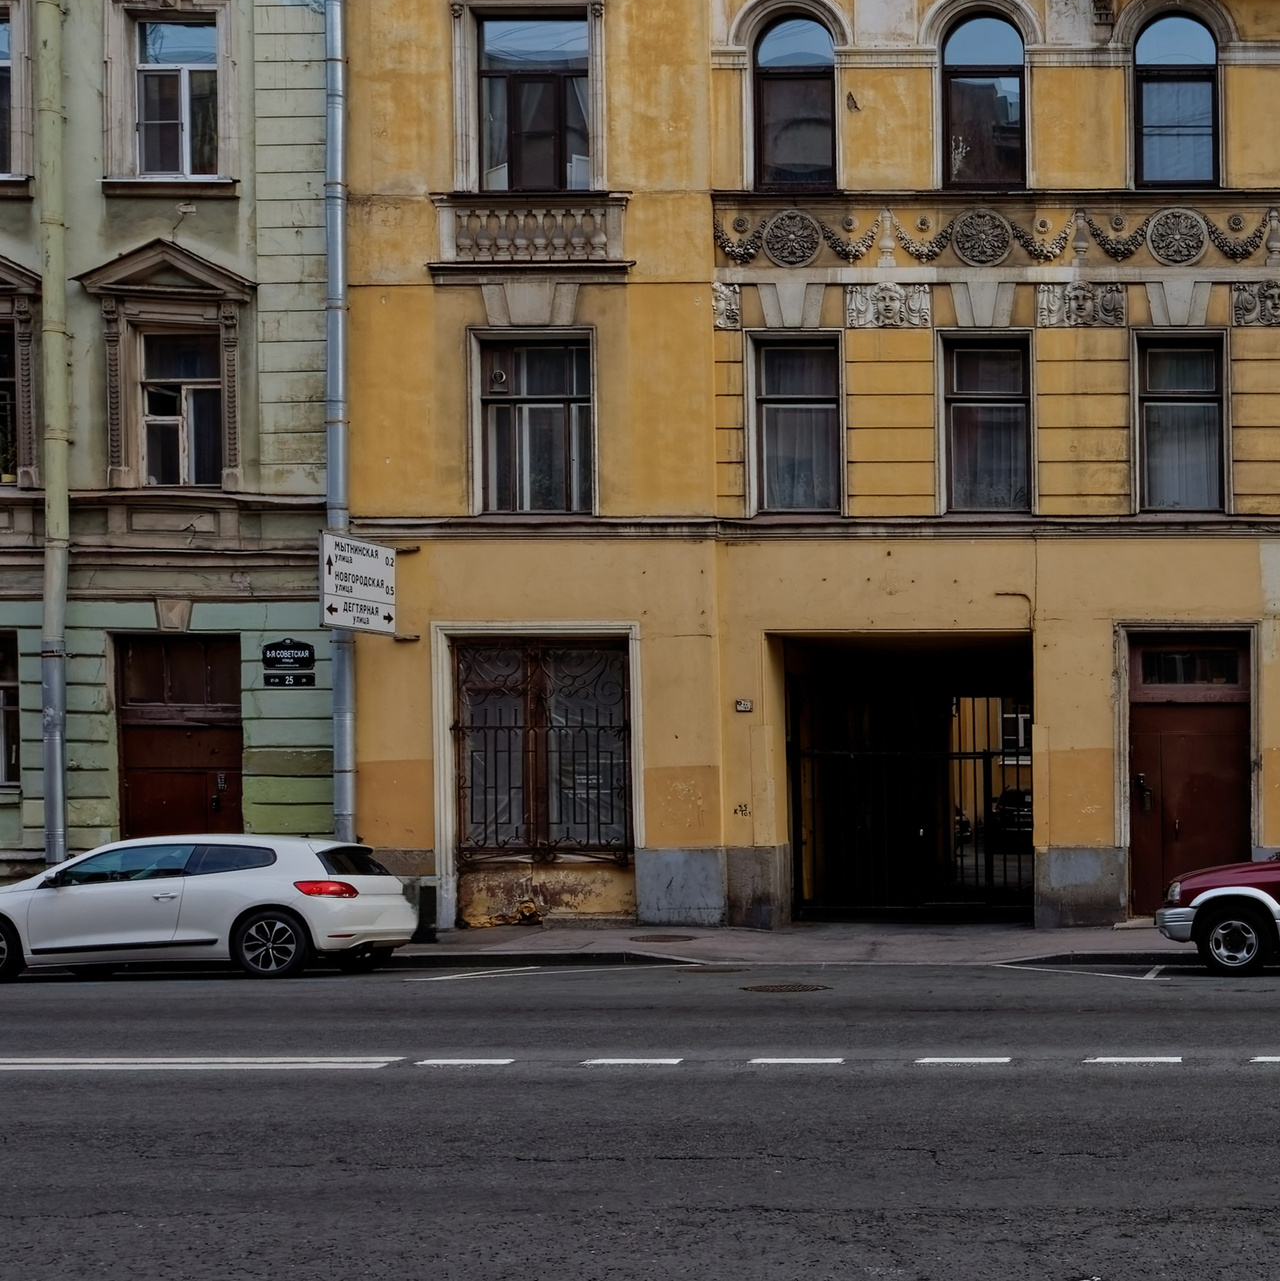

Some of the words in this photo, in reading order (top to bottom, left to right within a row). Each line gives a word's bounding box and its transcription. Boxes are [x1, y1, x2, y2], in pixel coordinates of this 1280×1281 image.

[334, 541, 379, 559] МЫТНИНСКАЯ
[334, 554, 353, 564] улица
[334, 571, 385, 589] НОВГОРОДСКАЯ
[334, 583, 353, 593] улица
[342, 601, 379, 616] ДЕГТЯРНАЯ
[352, 615, 370, 625] улица
[276, 650, 309, 658] СОВЕТСКАЯ
[285, 676, 294, 685] 25
